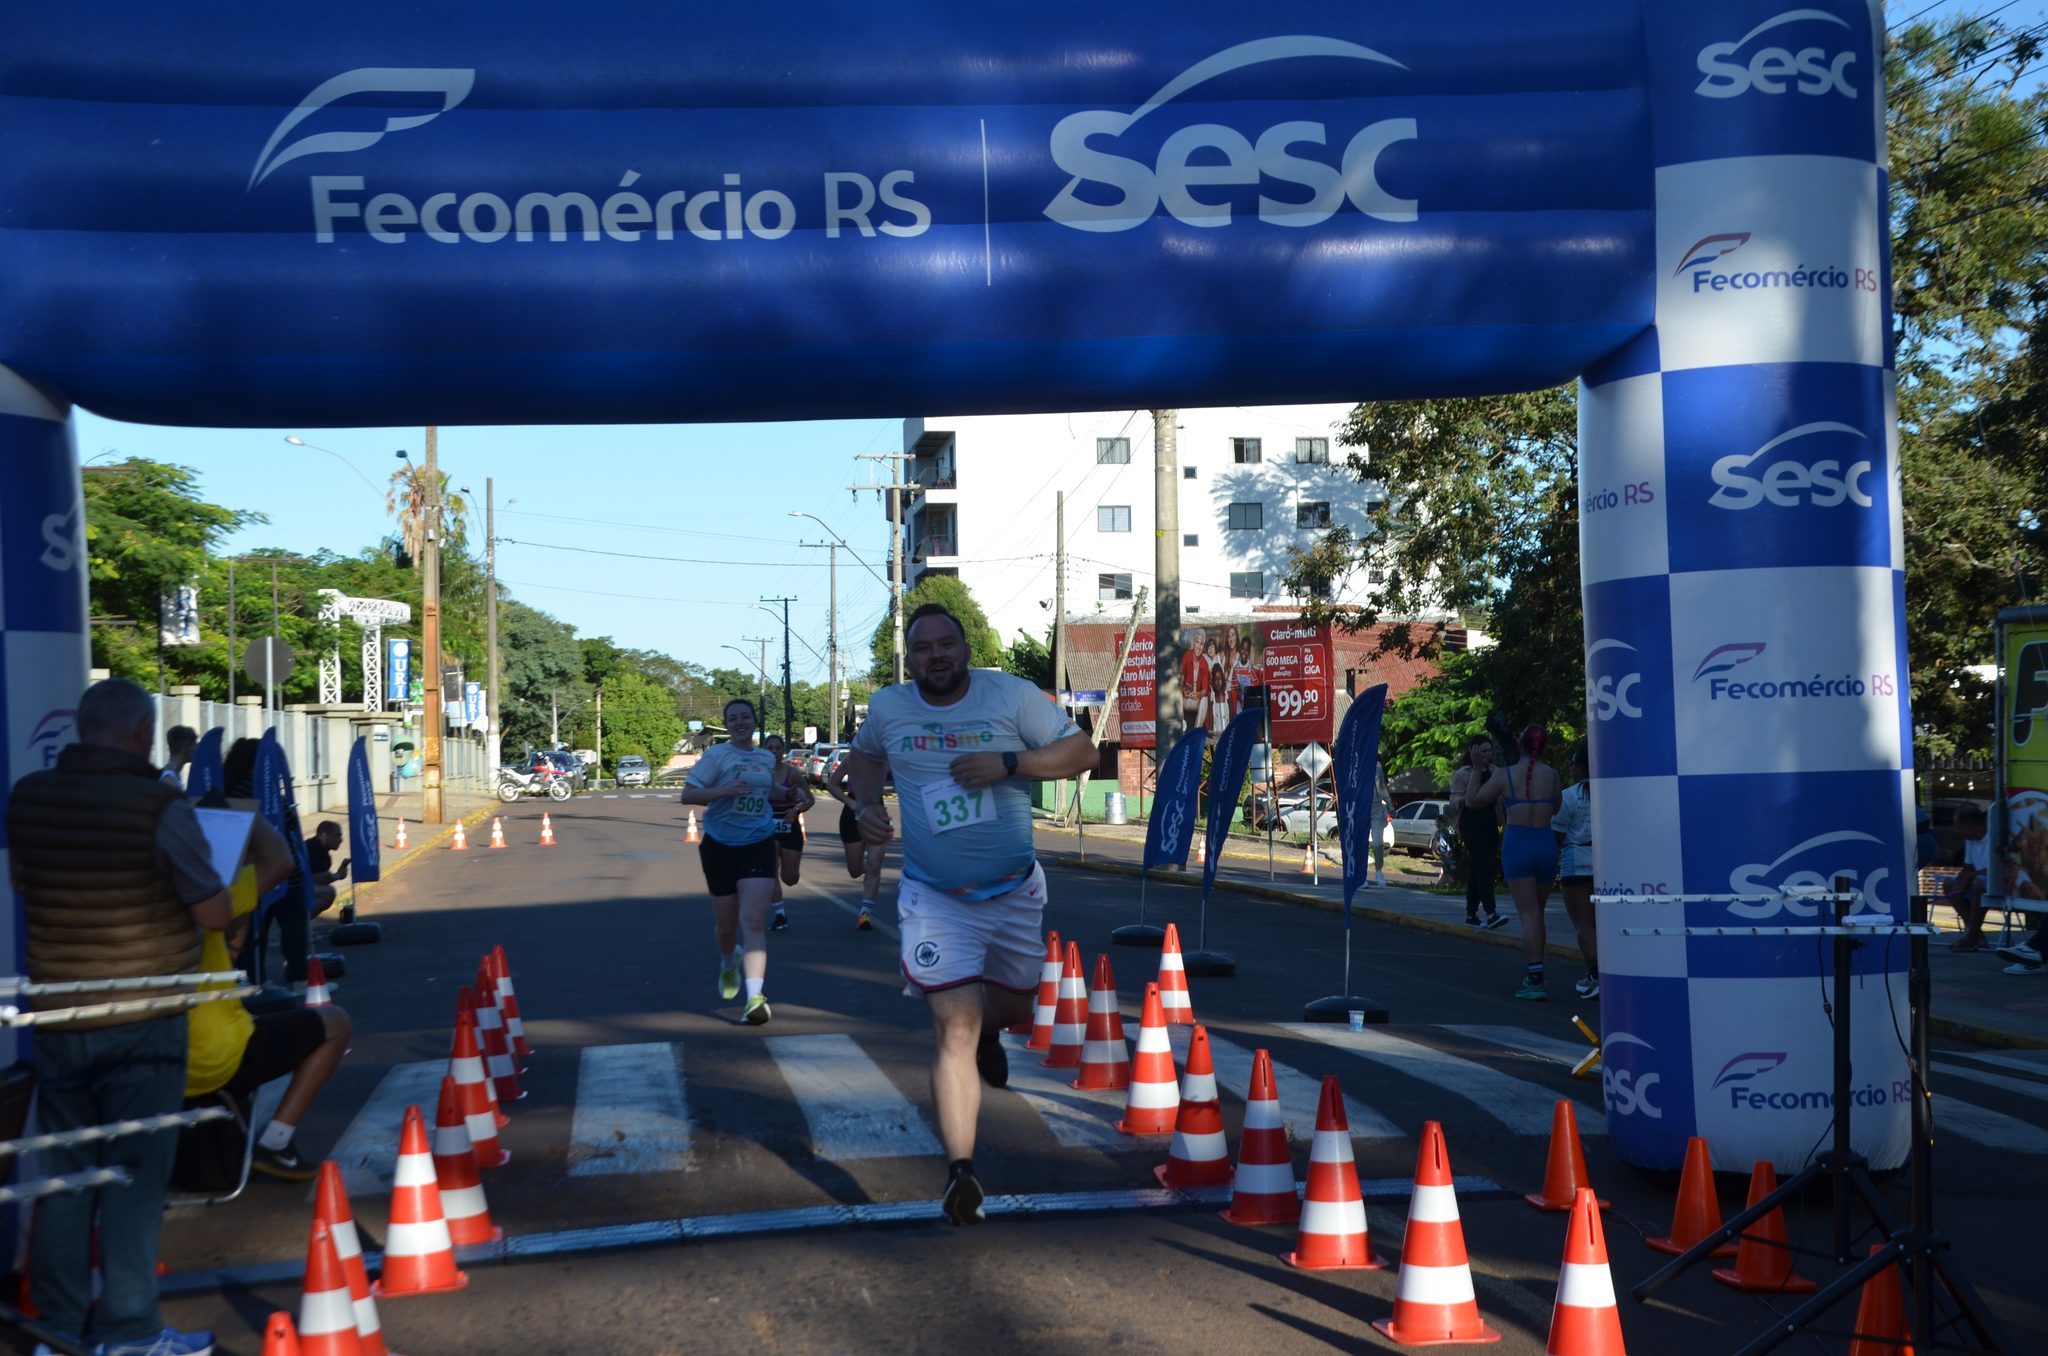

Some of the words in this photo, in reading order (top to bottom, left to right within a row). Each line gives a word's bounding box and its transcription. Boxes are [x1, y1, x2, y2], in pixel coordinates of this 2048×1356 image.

[1694, 40, 1858, 100] Sesc
[1042, 110, 1419, 233] Sesc
[310, 170, 796, 245] Fecomércio
[825, 170, 932, 240] RS
[1693, 263, 1848, 293] Fecomércio
[1855, 269, 1877, 293] RS
[1708, 453, 1872, 510] Sesc
[1584, 488, 1618, 513] ércio
[1624, 481, 1655, 506] RS
[1270, 628, 1291, 641] Claro
[1266, 657, 1279, 666] 600
[1279, 655, 1299, 665] MEGA
[1304, 654, 1314, 664] 60
[1304, 665, 1321, 675] GIGA
[394, 658, 408, 698] URI
[1138, 668, 1156, 681] Mult
[1711, 674, 1865, 701] Fecomércio
[1871, 674, 1893, 697] RS
[1128, 687, 1137, 697] na
[1587, 672, 1643, 721] esc
[468, 695, 478, 721] URI
[900, 730, 993, 752] Autismo
[736, 797, 764, 814] 509
[934, 790, 985, 827] 337
[1603, 1066, 1663, 1119] esc
[1731, 1083, 1886, 1110] Fecomrcio
